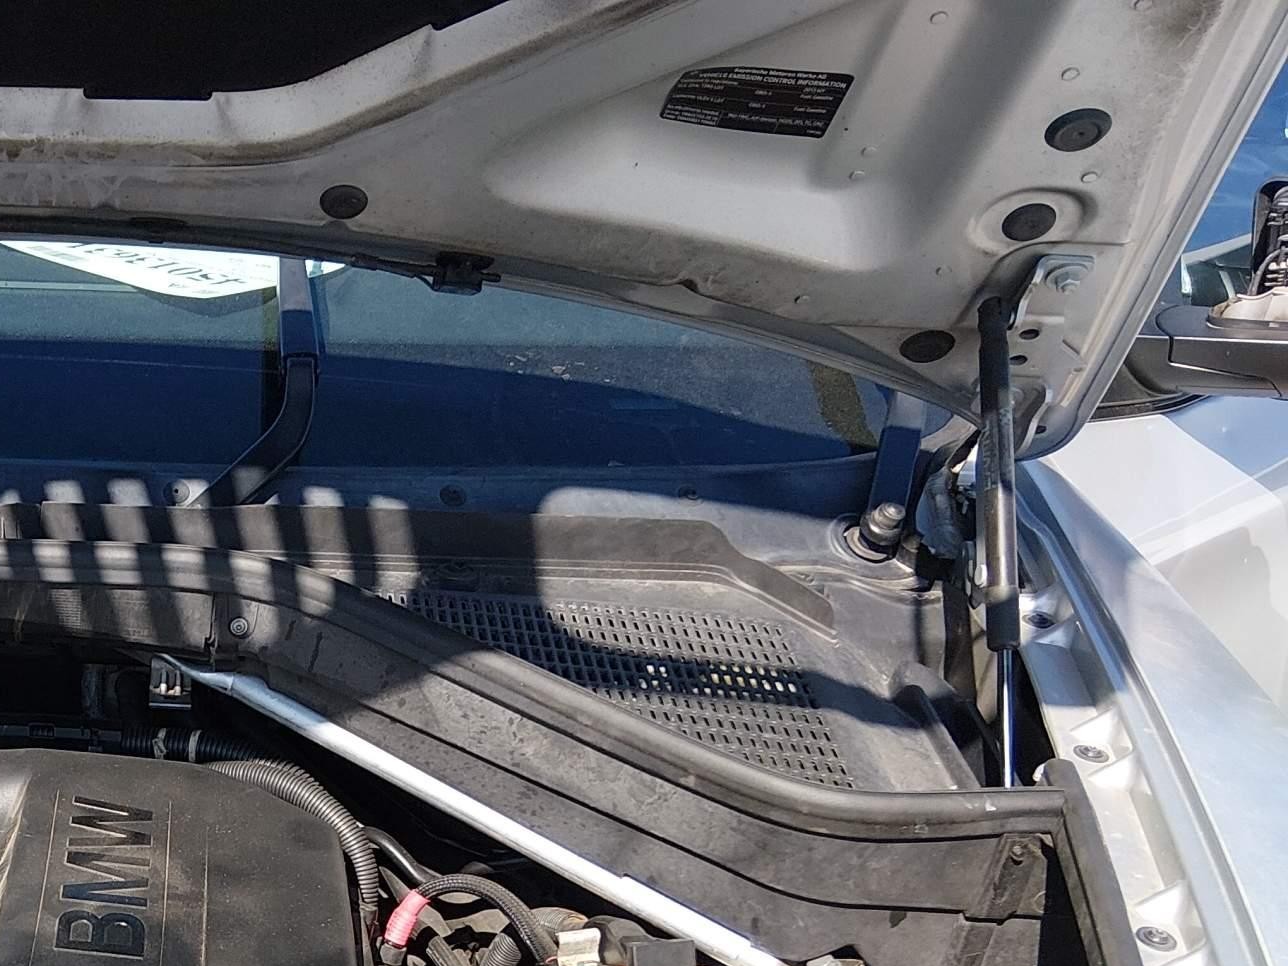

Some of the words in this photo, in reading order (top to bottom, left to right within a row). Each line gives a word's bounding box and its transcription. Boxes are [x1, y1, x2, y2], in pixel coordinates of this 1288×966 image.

[764, 76, 796, 85] CONTROL
[797, 79, 847, 88] INFORMATION
[53, 795, 154, 960] BMW
